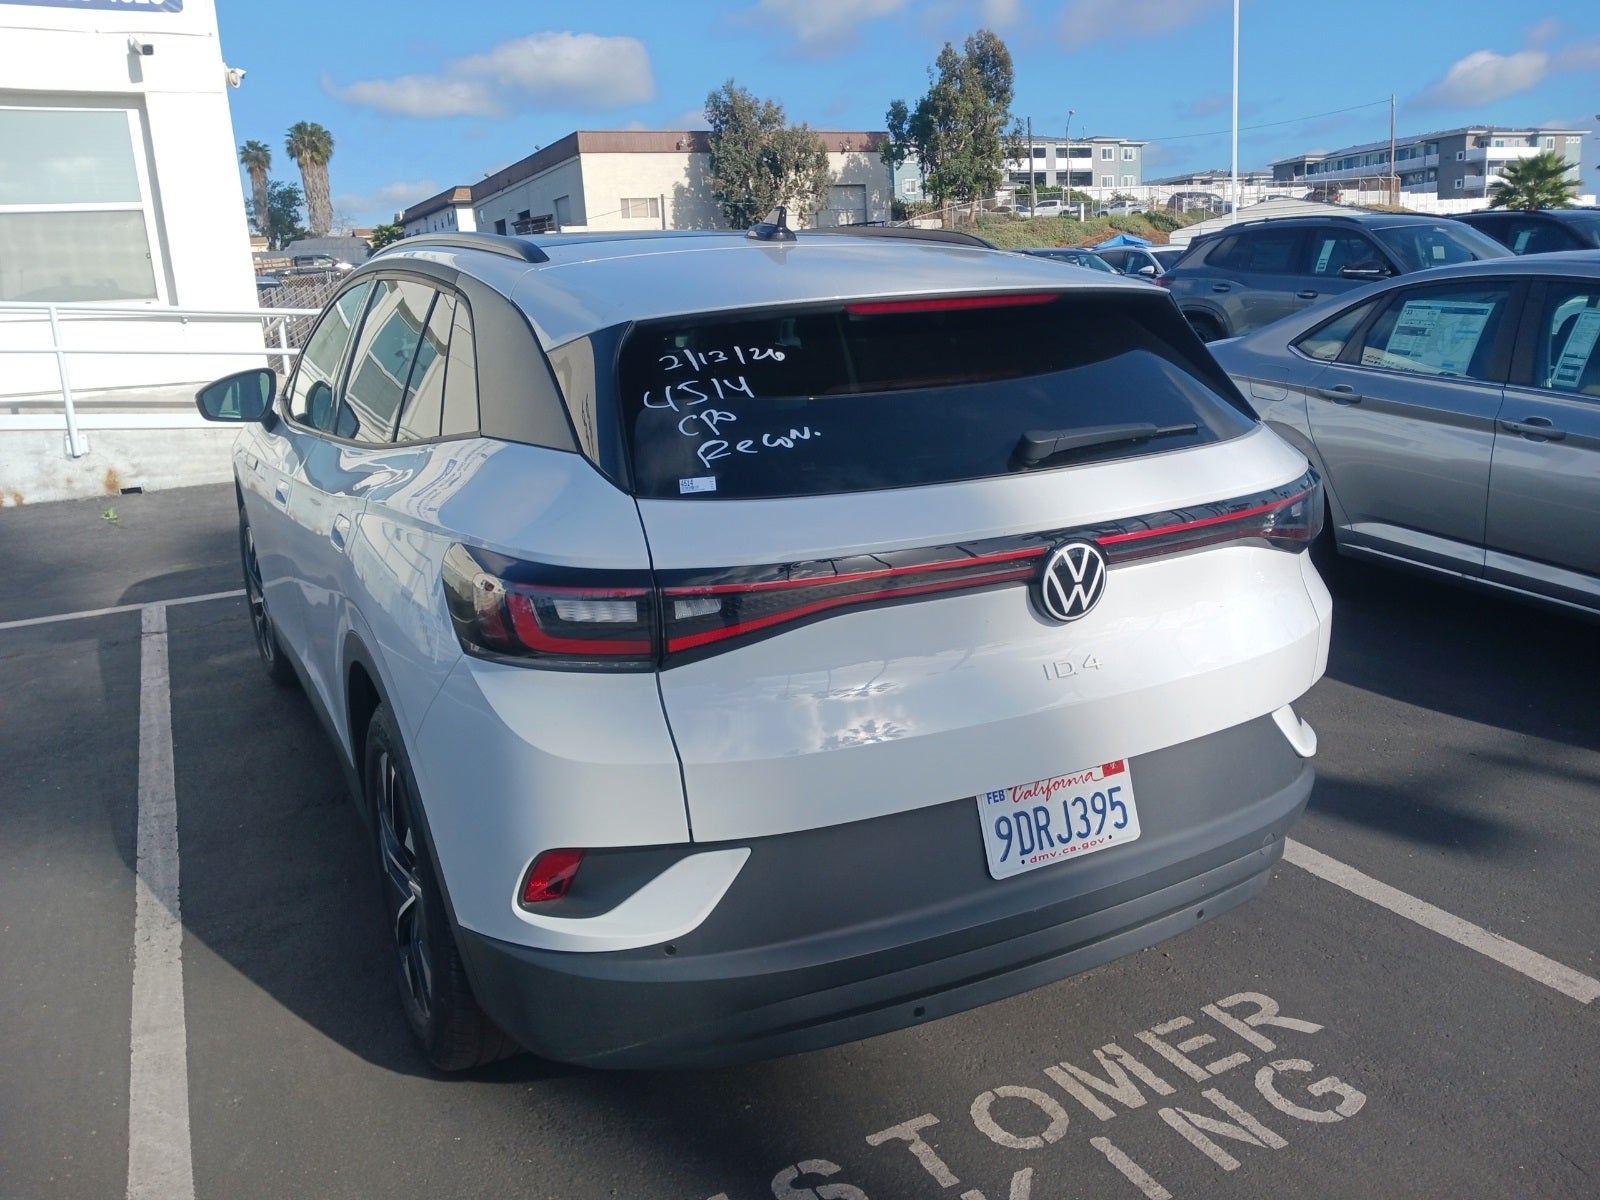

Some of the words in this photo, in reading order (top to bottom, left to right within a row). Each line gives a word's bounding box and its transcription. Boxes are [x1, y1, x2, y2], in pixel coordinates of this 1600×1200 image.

[643, 375, 755, 412] 4514
[1042, 654, 1103, 681] ID.4
[986, 789, 1006, 805] FEB
[1011, 770, 1105, 804] California
[994, 785, 1129, 863] 9DRJ395
[1029, 837, 1105, 864] dmv.ca.gov
[706, 991, 1325, 1200] STOMER
